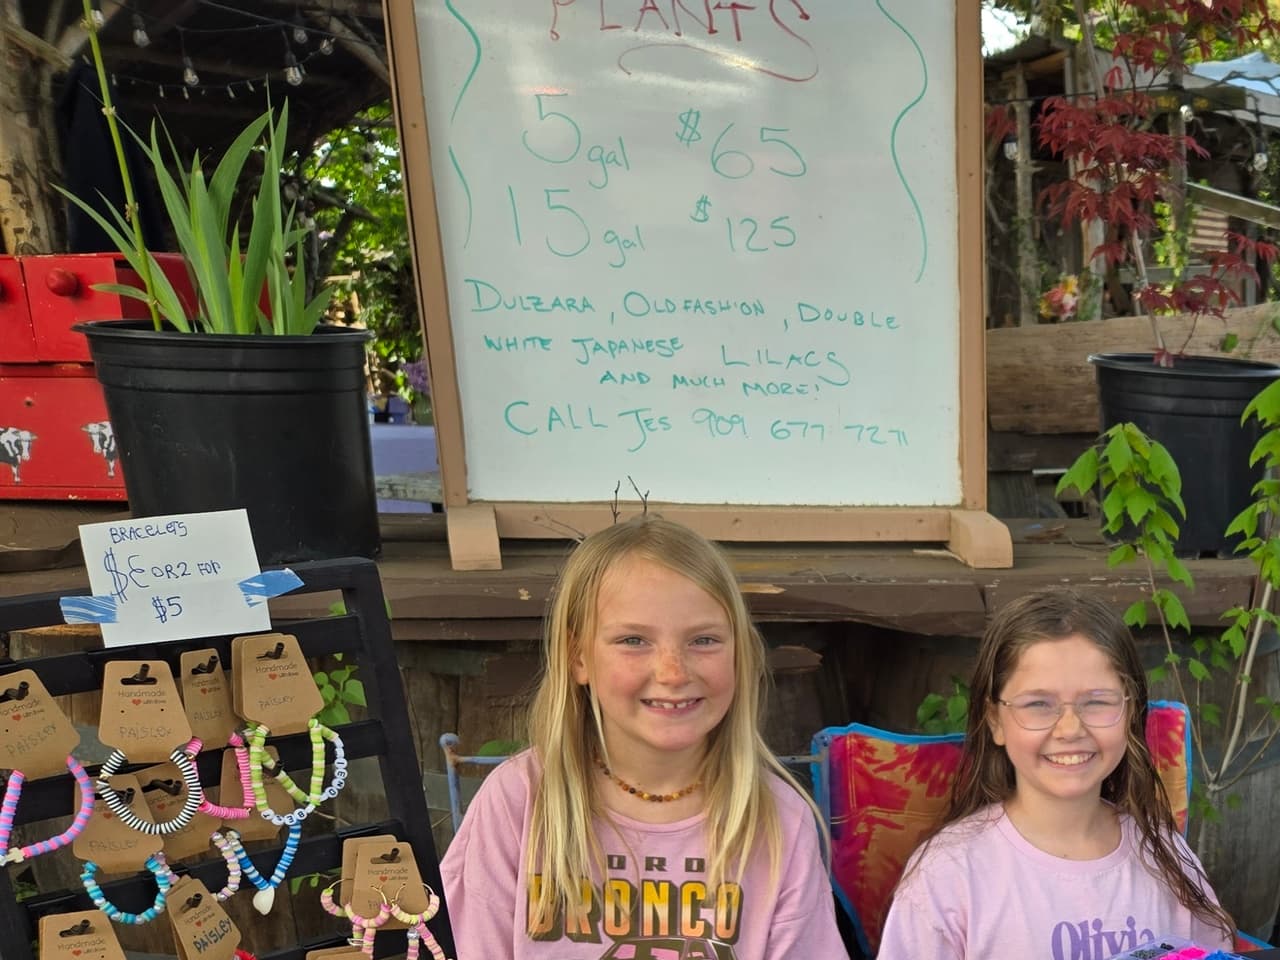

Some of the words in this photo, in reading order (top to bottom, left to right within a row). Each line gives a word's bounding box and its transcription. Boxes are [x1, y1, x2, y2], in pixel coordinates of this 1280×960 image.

[797, 302, 900, 329] DOUBLE
[484, 334, 552, 351] WHITE
[572, 337, 684, 365] JAPANESE
[721, 345, 850, 387] LILACS
[600, 371, 651, 384] AND
[672, 374, 726, 389] MUCH
[504, 401, 608, 435] CALL
[692, 408, 748, 438] 909
[770, 420, 825, 440] 677
[152, 596, 183, 623] $5
[255, 663, 298, 673] Handmade
[607, 854, 705, 873] ORD
[526, 872, 743, 944] BRONCO
